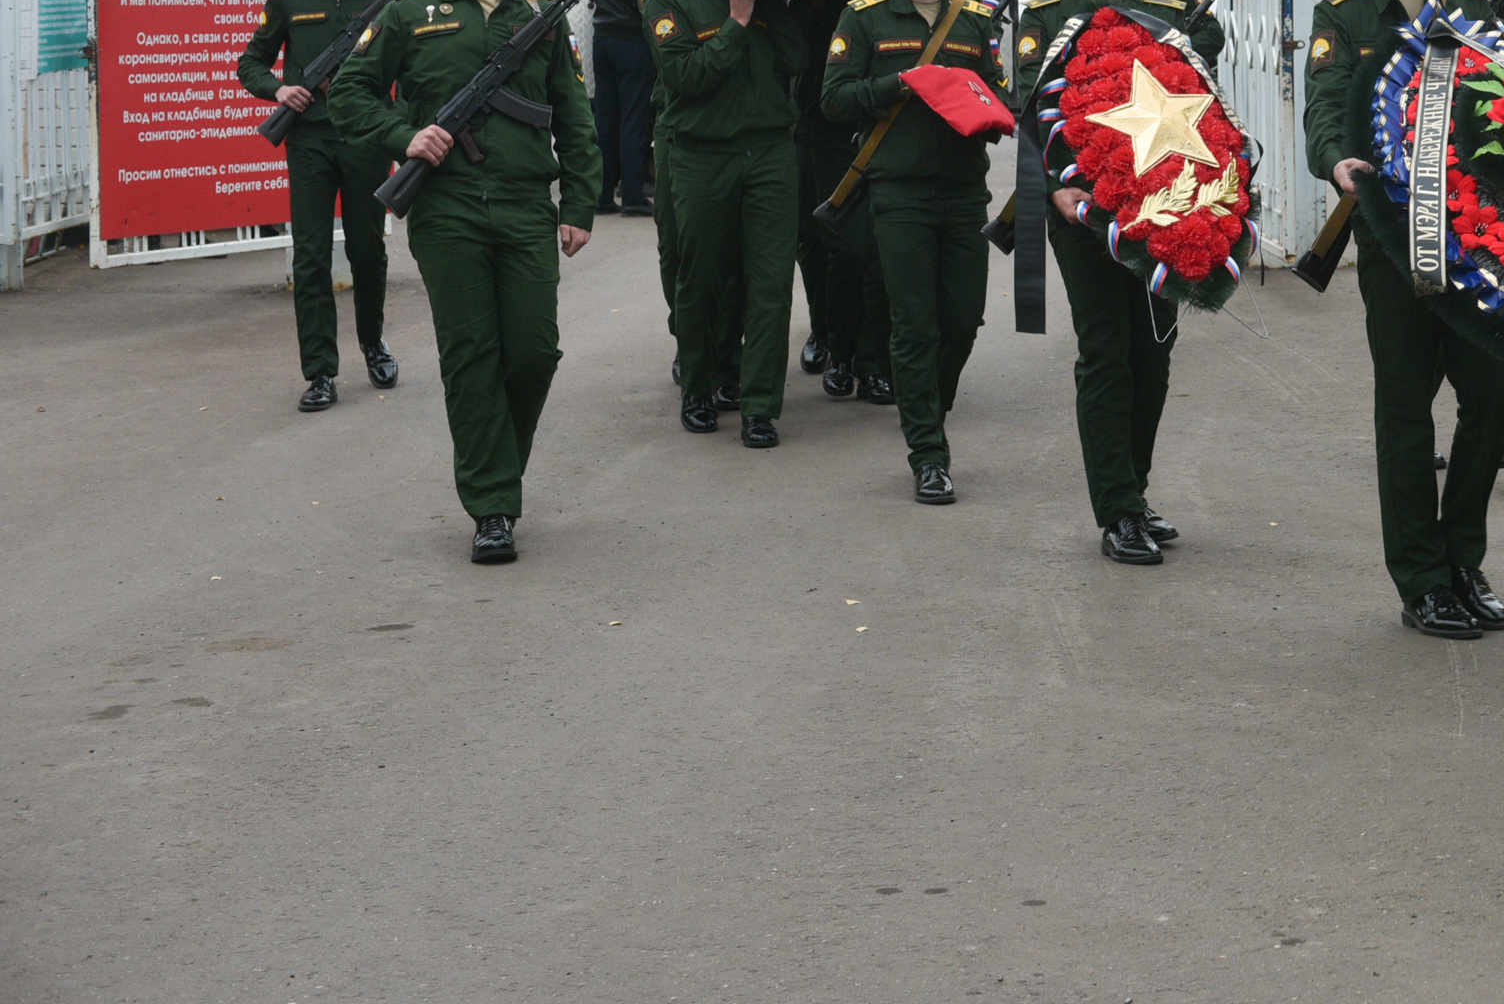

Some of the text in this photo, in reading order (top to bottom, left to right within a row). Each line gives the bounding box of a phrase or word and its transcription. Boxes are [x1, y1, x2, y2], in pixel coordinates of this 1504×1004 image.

[214, 13, 244, 24] своих
[136, 32, 182, 46] Однако,
[184, 34, 190, 44] в
[192, 33, 221, 44] связи
[222, 33, 229, 44] с
[118, 49, 209, 67] коронавирусной
[128, 70, 210, 84] самоизоляции,
[212, 70, 228, 81] мы
[144, 92, 157, 103] на
[159, 88, 214, 103] кладбище
[219, 88, 234, 101] (за
[123, 110, 150, 124] Вход
[152, 111, 165, 122] на
[167, 106, 222, 122] кладбище
[224, 105, 253, 120] будет
[1415, 56, 1452, 272] ОТ МЭРА Г. НАБЕРЕЖНЫЕ ЧЕЛНЫ
[118, 168, 161, 184] Просим
[163, 165, 217, 179] отнестись
[219, 164, 226, 175] с
[215, 180, 261, 196] Берегите
